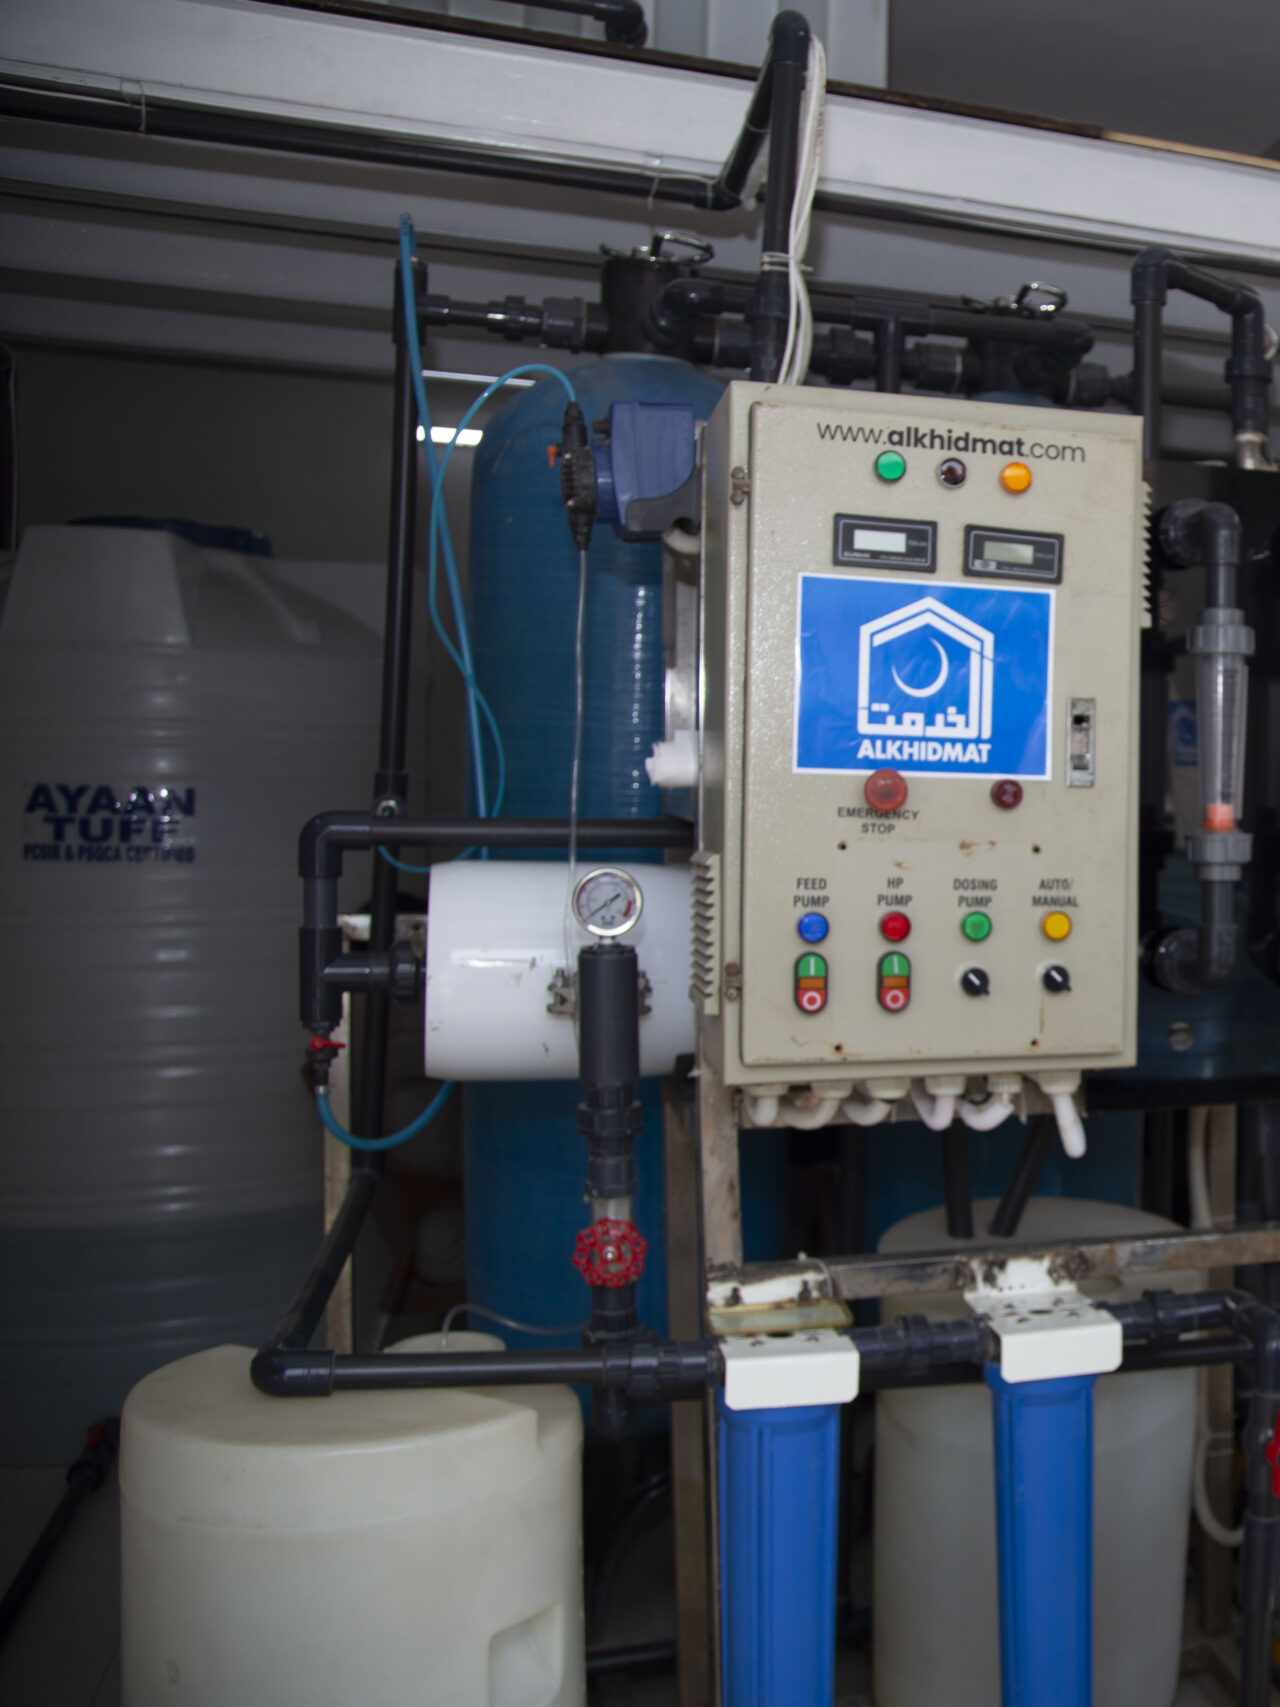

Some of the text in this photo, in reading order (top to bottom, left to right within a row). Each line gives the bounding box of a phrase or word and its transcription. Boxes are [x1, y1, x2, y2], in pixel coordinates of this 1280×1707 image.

[816, 421, 1086, 463] www.alkhidmat.com
[857, 739, 992, 765] ALKHIDMAT
[24, 783, 196, 816] AYAAN
[861, 823, 896, 834] STOP
[64, 845, 74, 862] &
[796, 878, 828, 891] FEED
[887, 877, 904, 890] HP
[953, 878, 998, 892] DOSING
[1039, 878, 1074, 891] AUTO/
[793, 895, 830, 908] PUMP
[877, 895, 913, 907] PUMP
[958, 896, 993, 908] PUMP
[1032, 896, 1079, 908] MANUAL
